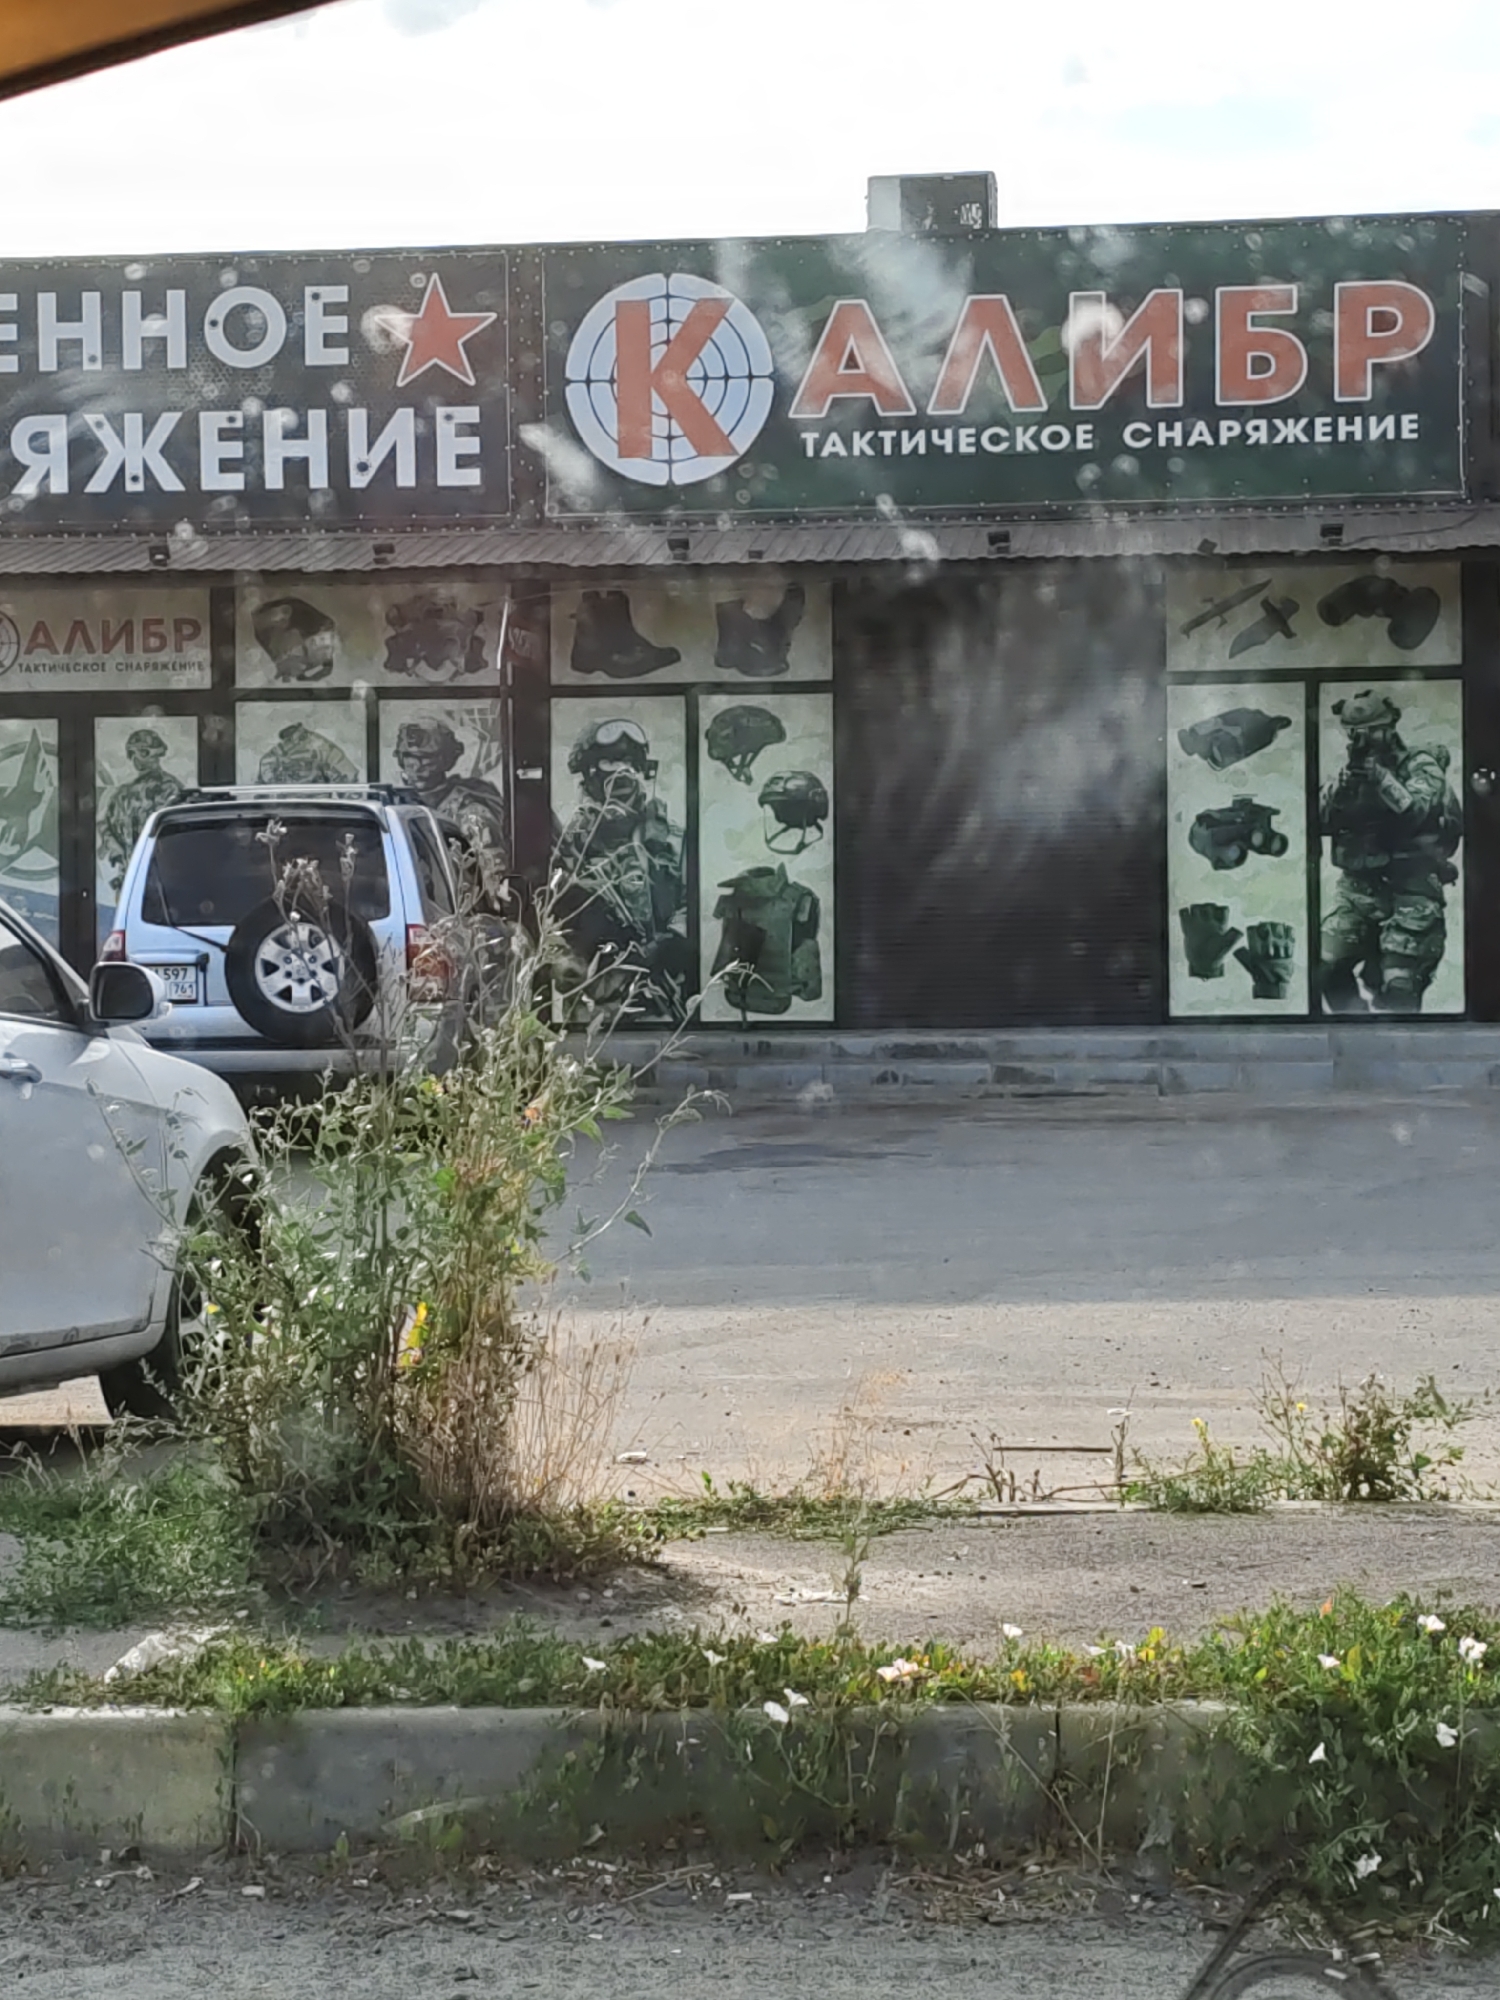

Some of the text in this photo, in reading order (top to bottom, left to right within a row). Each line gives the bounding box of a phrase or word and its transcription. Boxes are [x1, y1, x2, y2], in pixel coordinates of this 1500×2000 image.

[10, 406, 481, 494] ЯЖЕНИЕ
[801, 413, 1418, 457] ТАКТИЧЕСКОЕ СНАРЯЖЕНИЕ
[0, 618, 202, 667] АЛИБР
[18, 661, 205, 674] ТАКТИЧЕСКОЕ СНАРЯЖЕНИЕ
